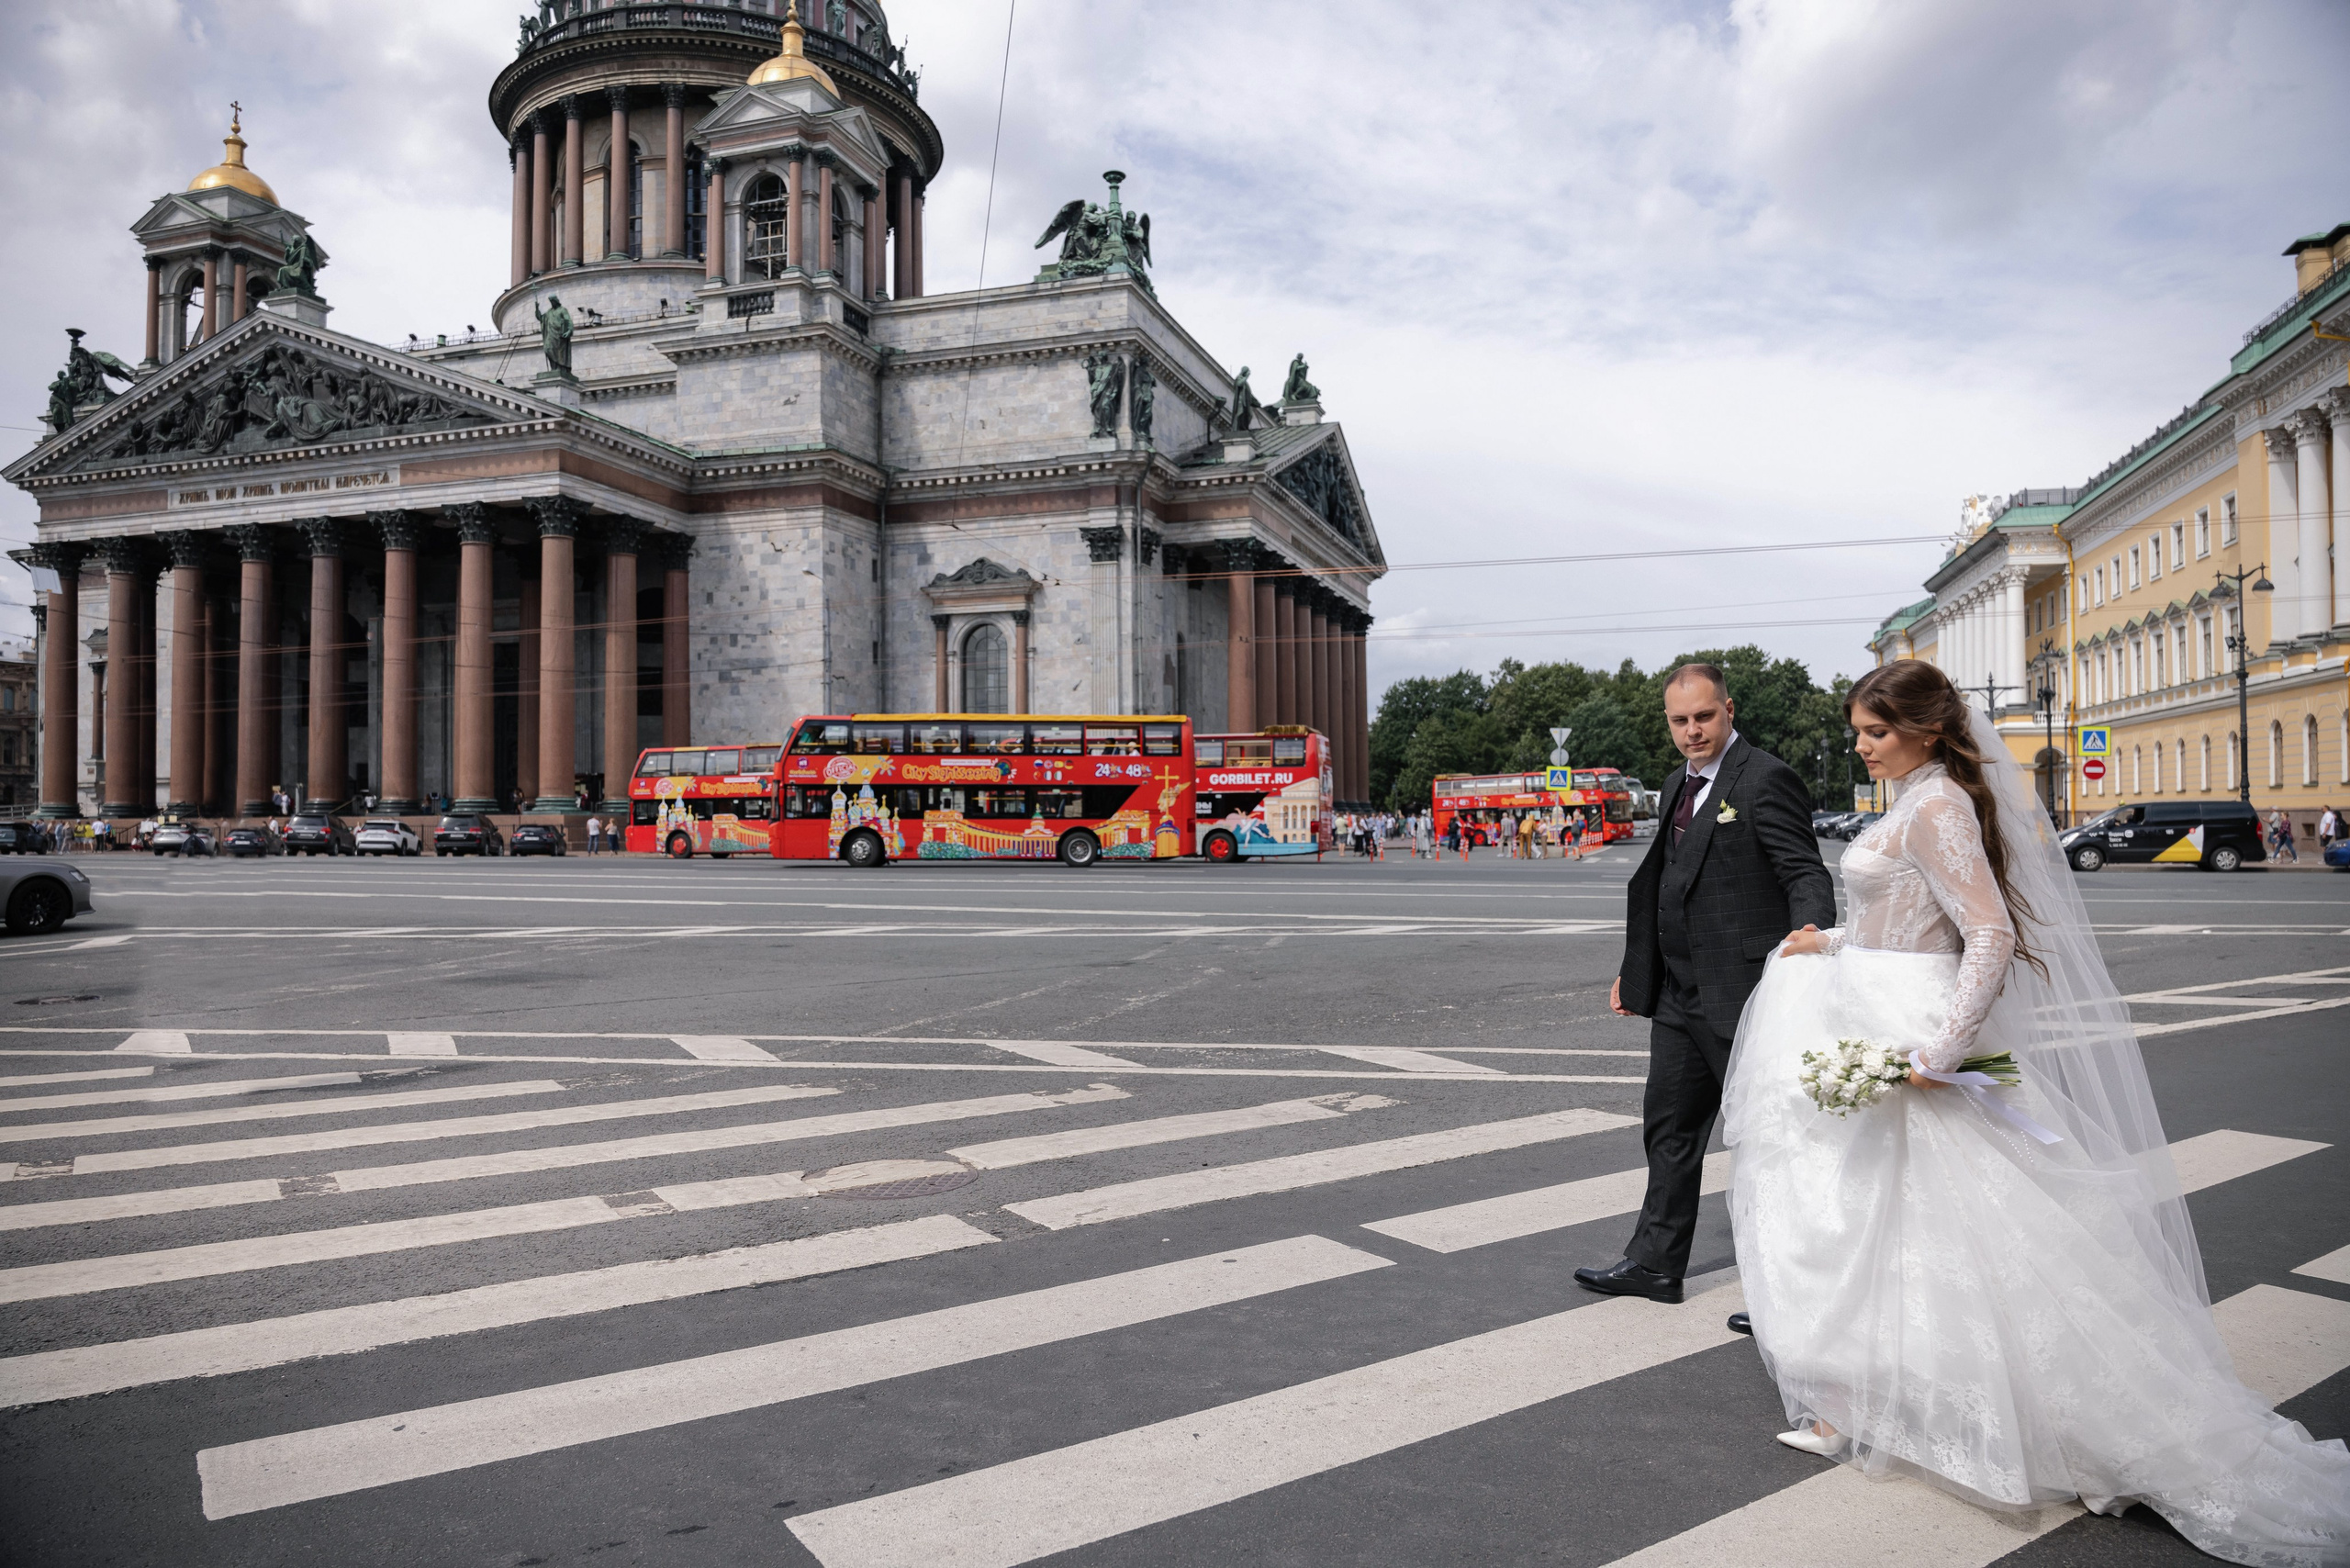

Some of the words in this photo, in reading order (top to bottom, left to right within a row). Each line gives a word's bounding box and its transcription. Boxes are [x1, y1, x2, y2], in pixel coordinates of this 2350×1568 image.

[902, 764, 927, 781] City
[928, 764, 1002, 782] Sightseeing
[1094, 763, 1111, 778] 24
[1125, 764, 1142, 778] 48
[1209, 772, 1293, 785] GORBILET.RU
